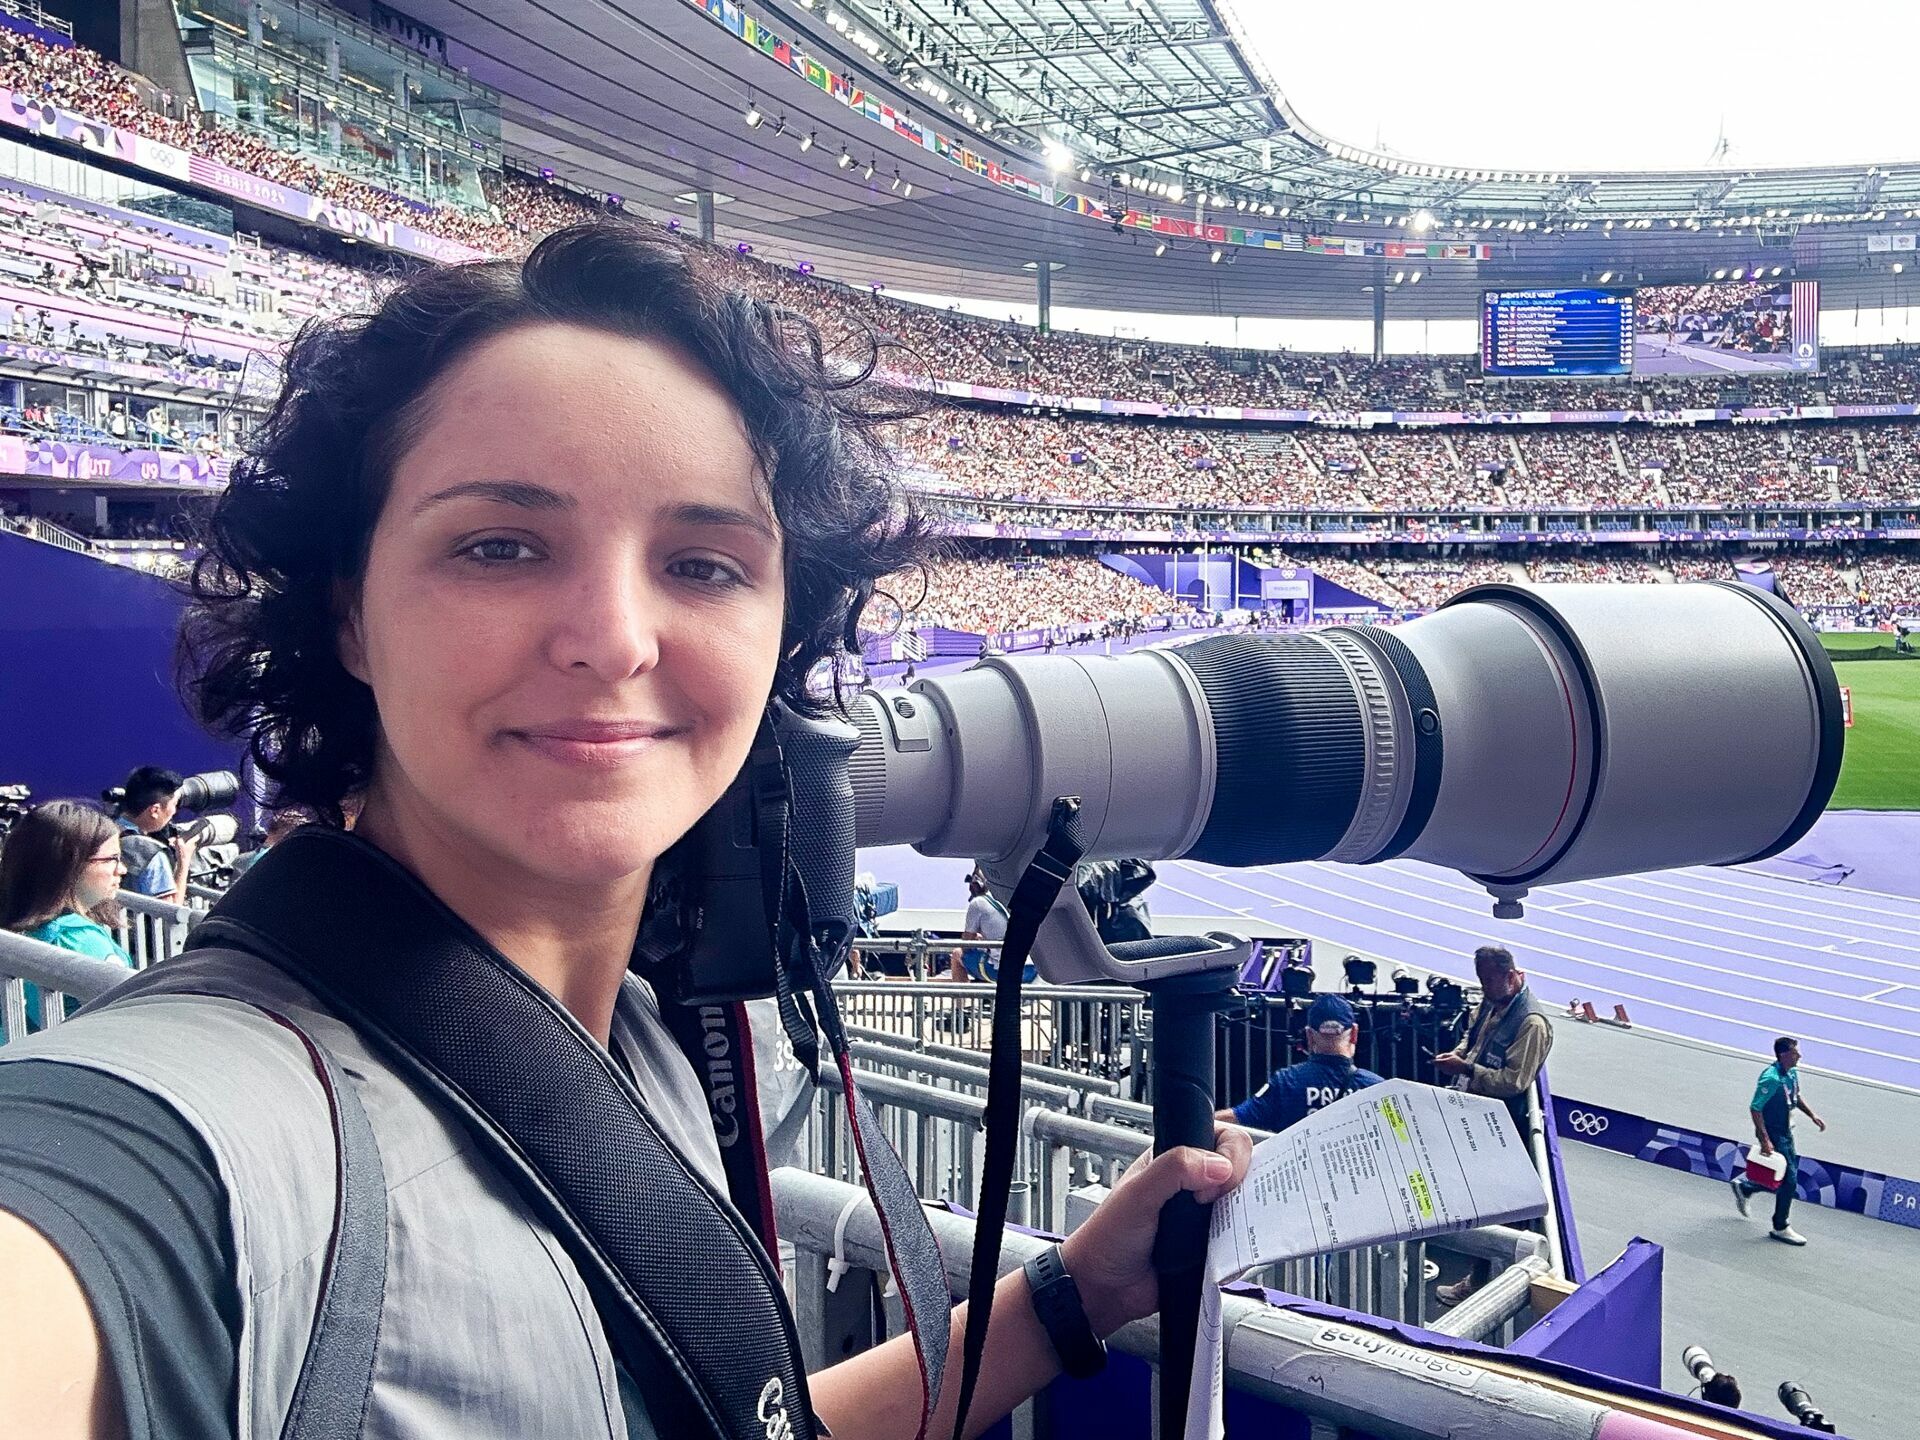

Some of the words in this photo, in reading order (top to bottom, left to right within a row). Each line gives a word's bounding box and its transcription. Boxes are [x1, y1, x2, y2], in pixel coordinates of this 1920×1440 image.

[214, 170, 252, 193] PARIS
[254, 183, 287, 205] 2024
[698, 1006, 739, 1148] Canon
[1465, 1130, 1473, 1140] AUG
[1469, 1140, 1478, 1152] 2024
[1497, 1131, 1507, 1148] France
[1400, 1187, 1408, 1200] Start
[1319, 1326, 1473, 1377] gettyimages
